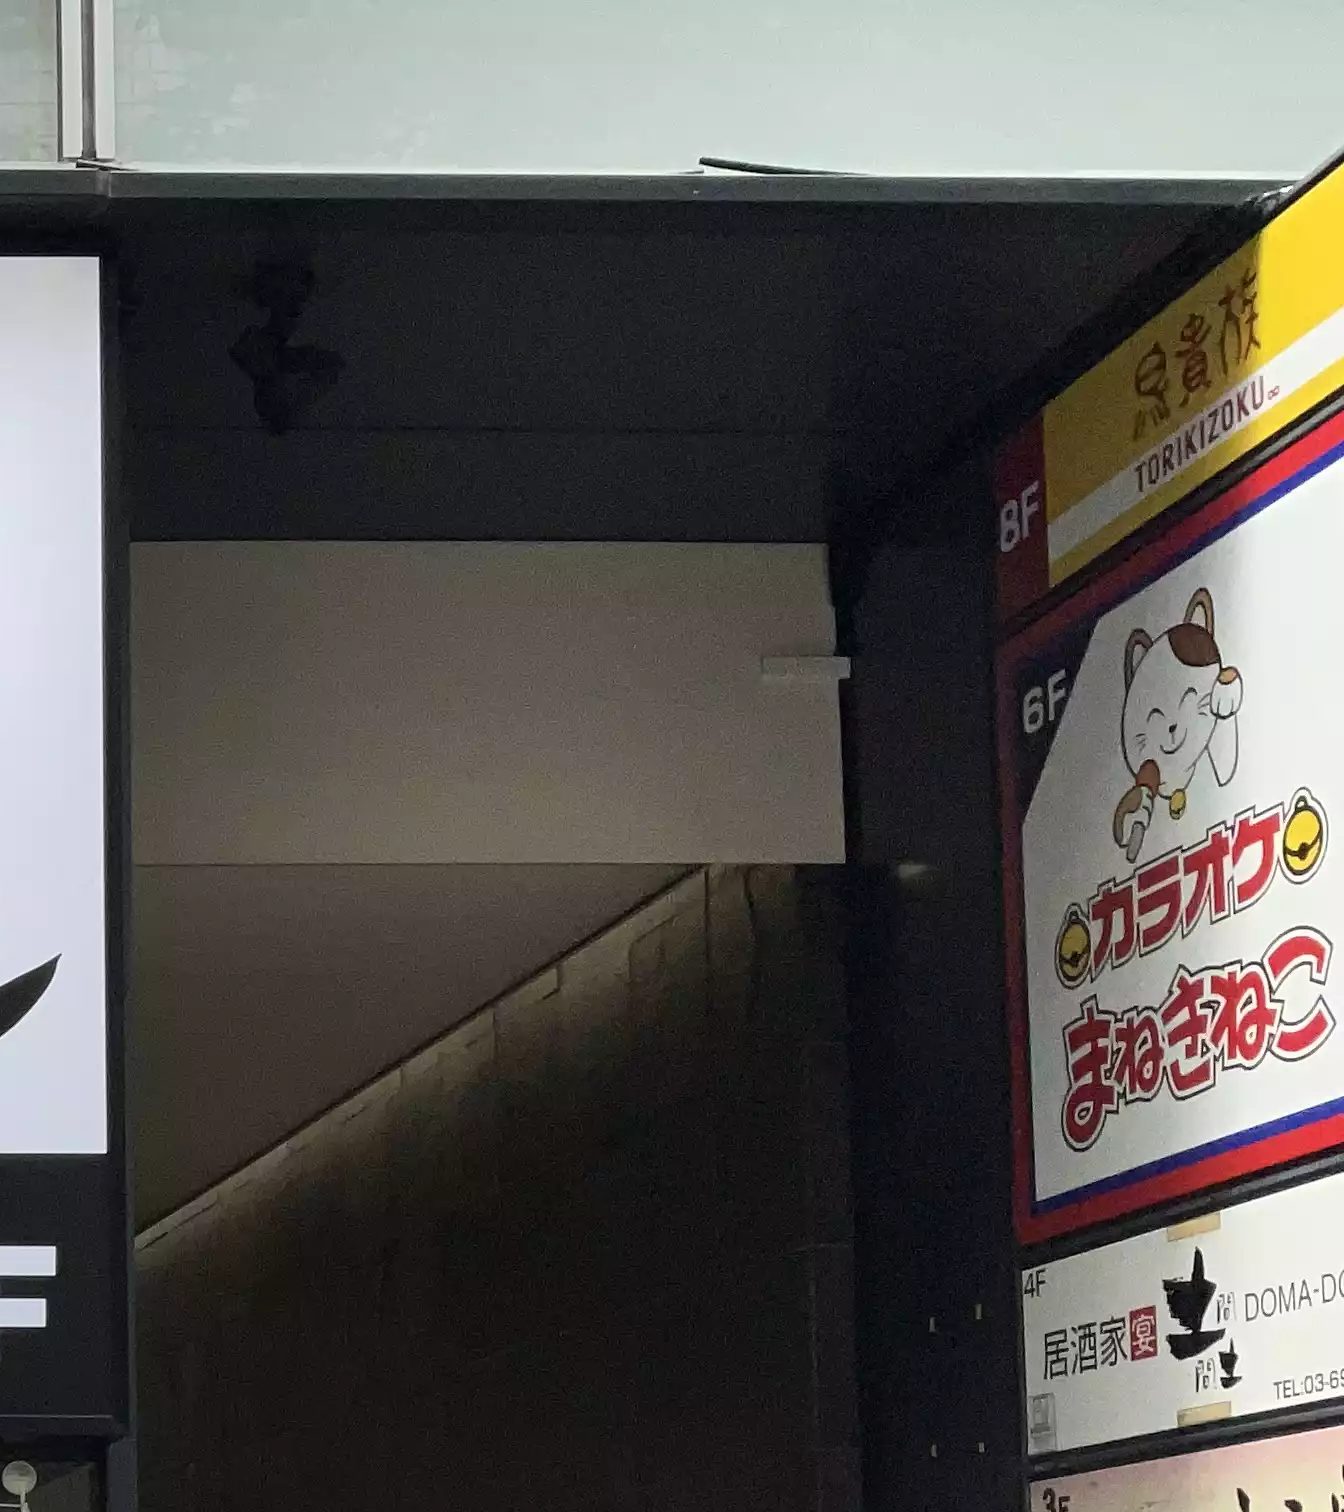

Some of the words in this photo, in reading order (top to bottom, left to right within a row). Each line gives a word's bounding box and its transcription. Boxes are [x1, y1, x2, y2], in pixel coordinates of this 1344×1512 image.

[1134, 376, 1264, 492] TORIKIZOKU
[999, 481, 1038, 552] 8F
[1023, 669, 1066, 733] 6F
[1089, 803, 1284, 981] カラオケ
[1062, 926, 1335, 1151] まねきねこ
[1024, 1269, 1046, 1297] 4F
